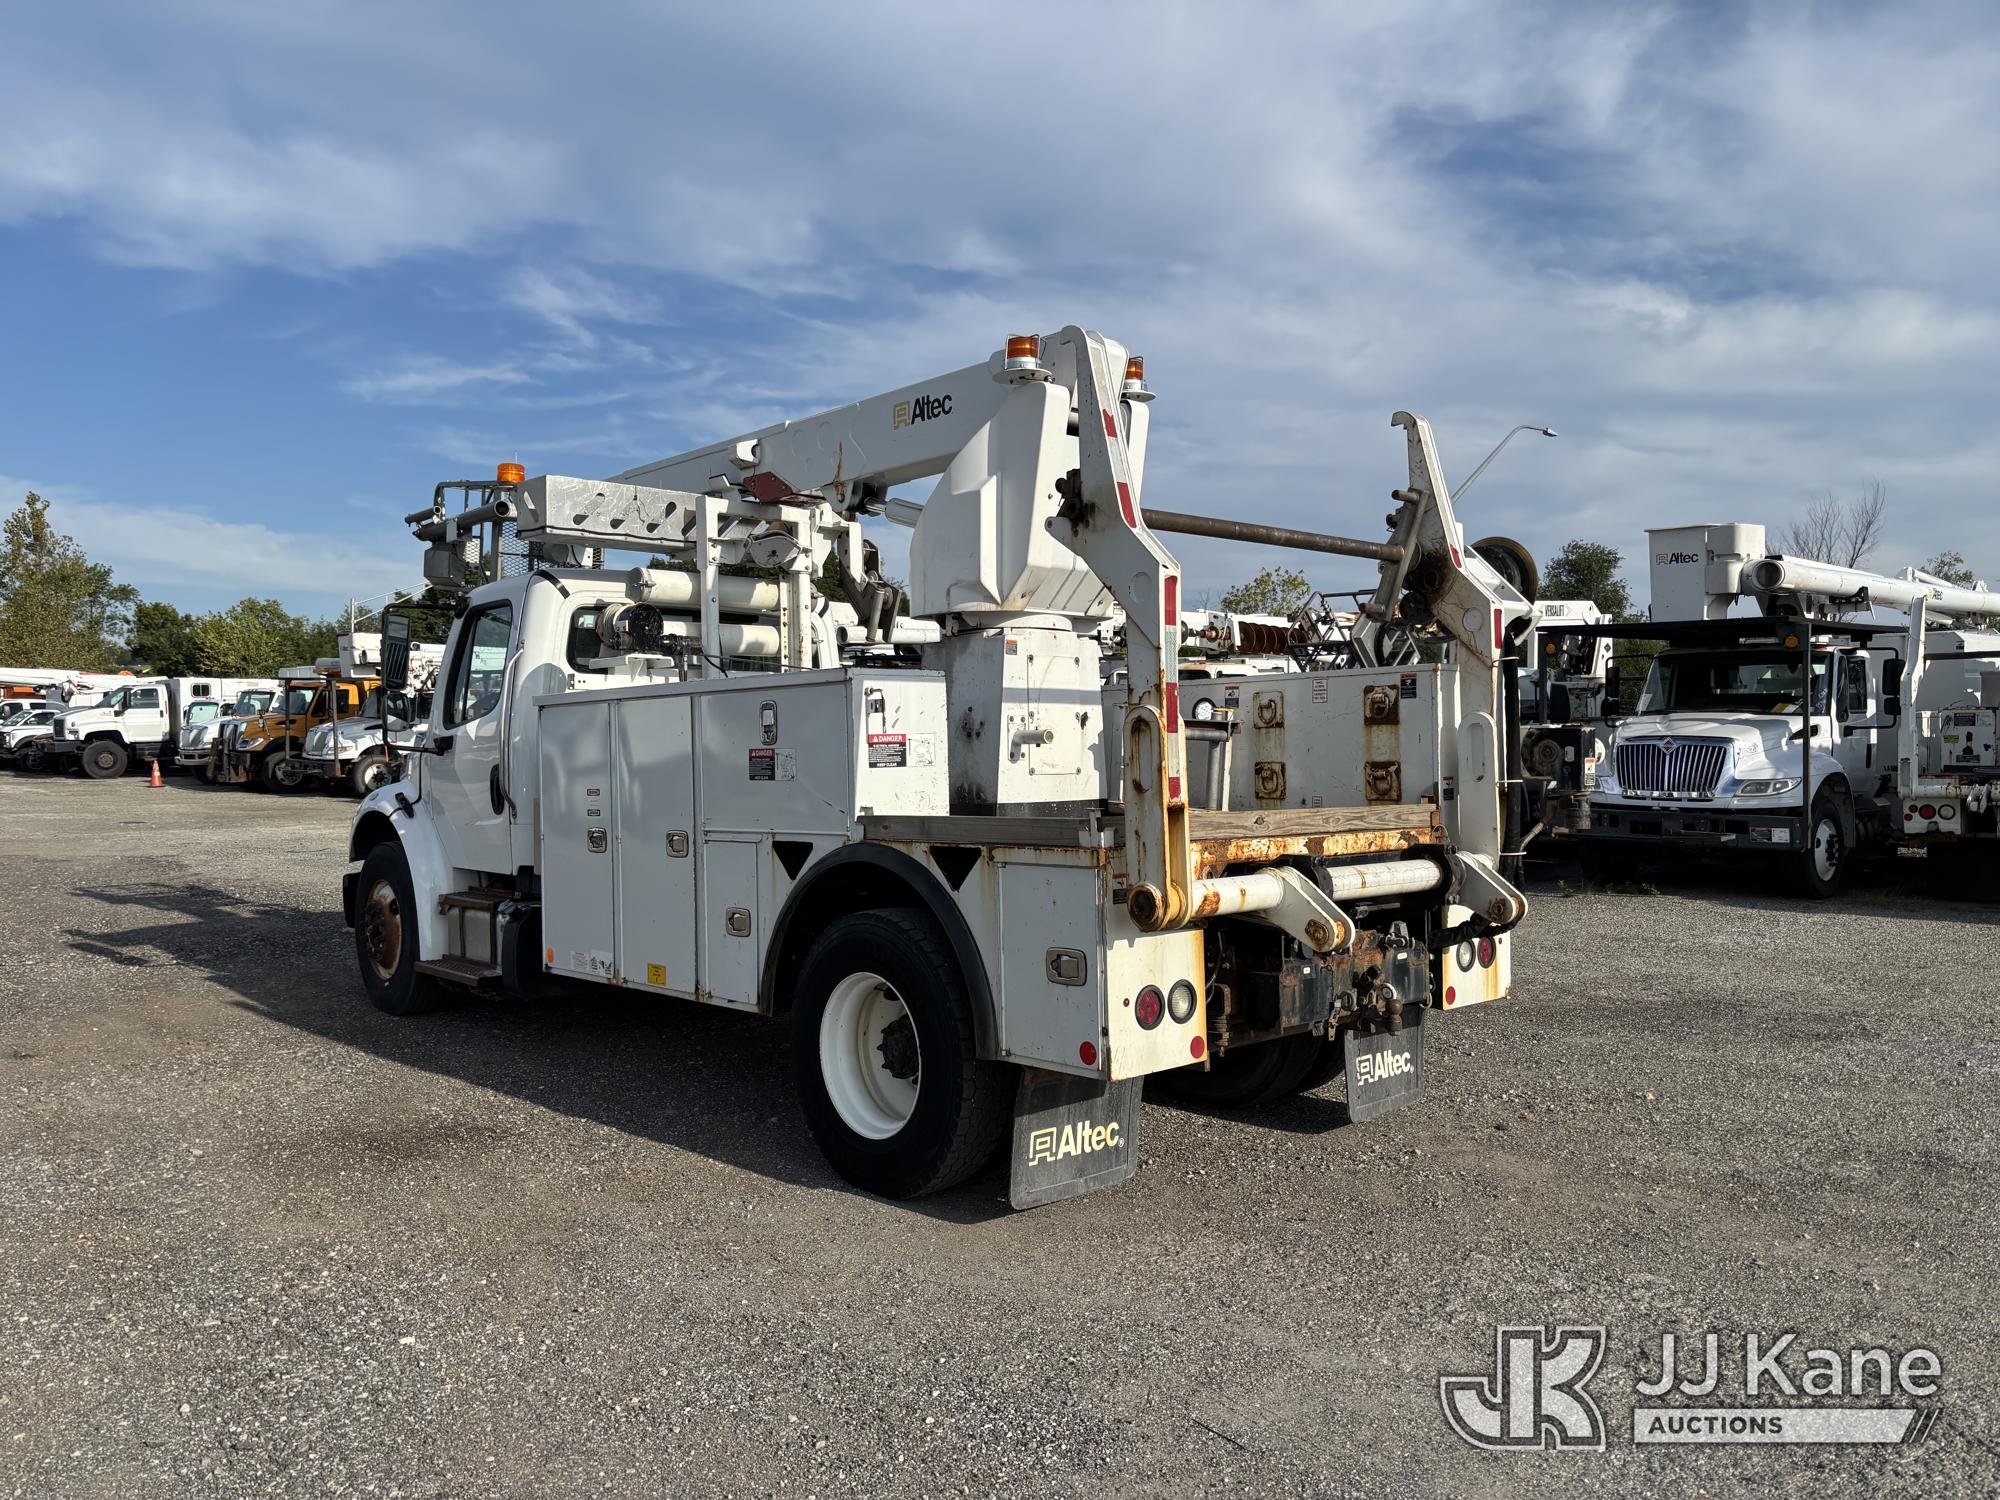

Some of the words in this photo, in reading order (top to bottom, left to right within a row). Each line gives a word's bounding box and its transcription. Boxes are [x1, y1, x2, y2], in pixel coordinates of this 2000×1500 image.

[911, 394, 953, 425] Altec
[1669, 552, 1699, 565] Altec
[1544, 604, 1565, 617] VERSALIFT
[1374, 1050, 1412, 1080] Altec
[1057, 1120, 1120, 1160] Altec
